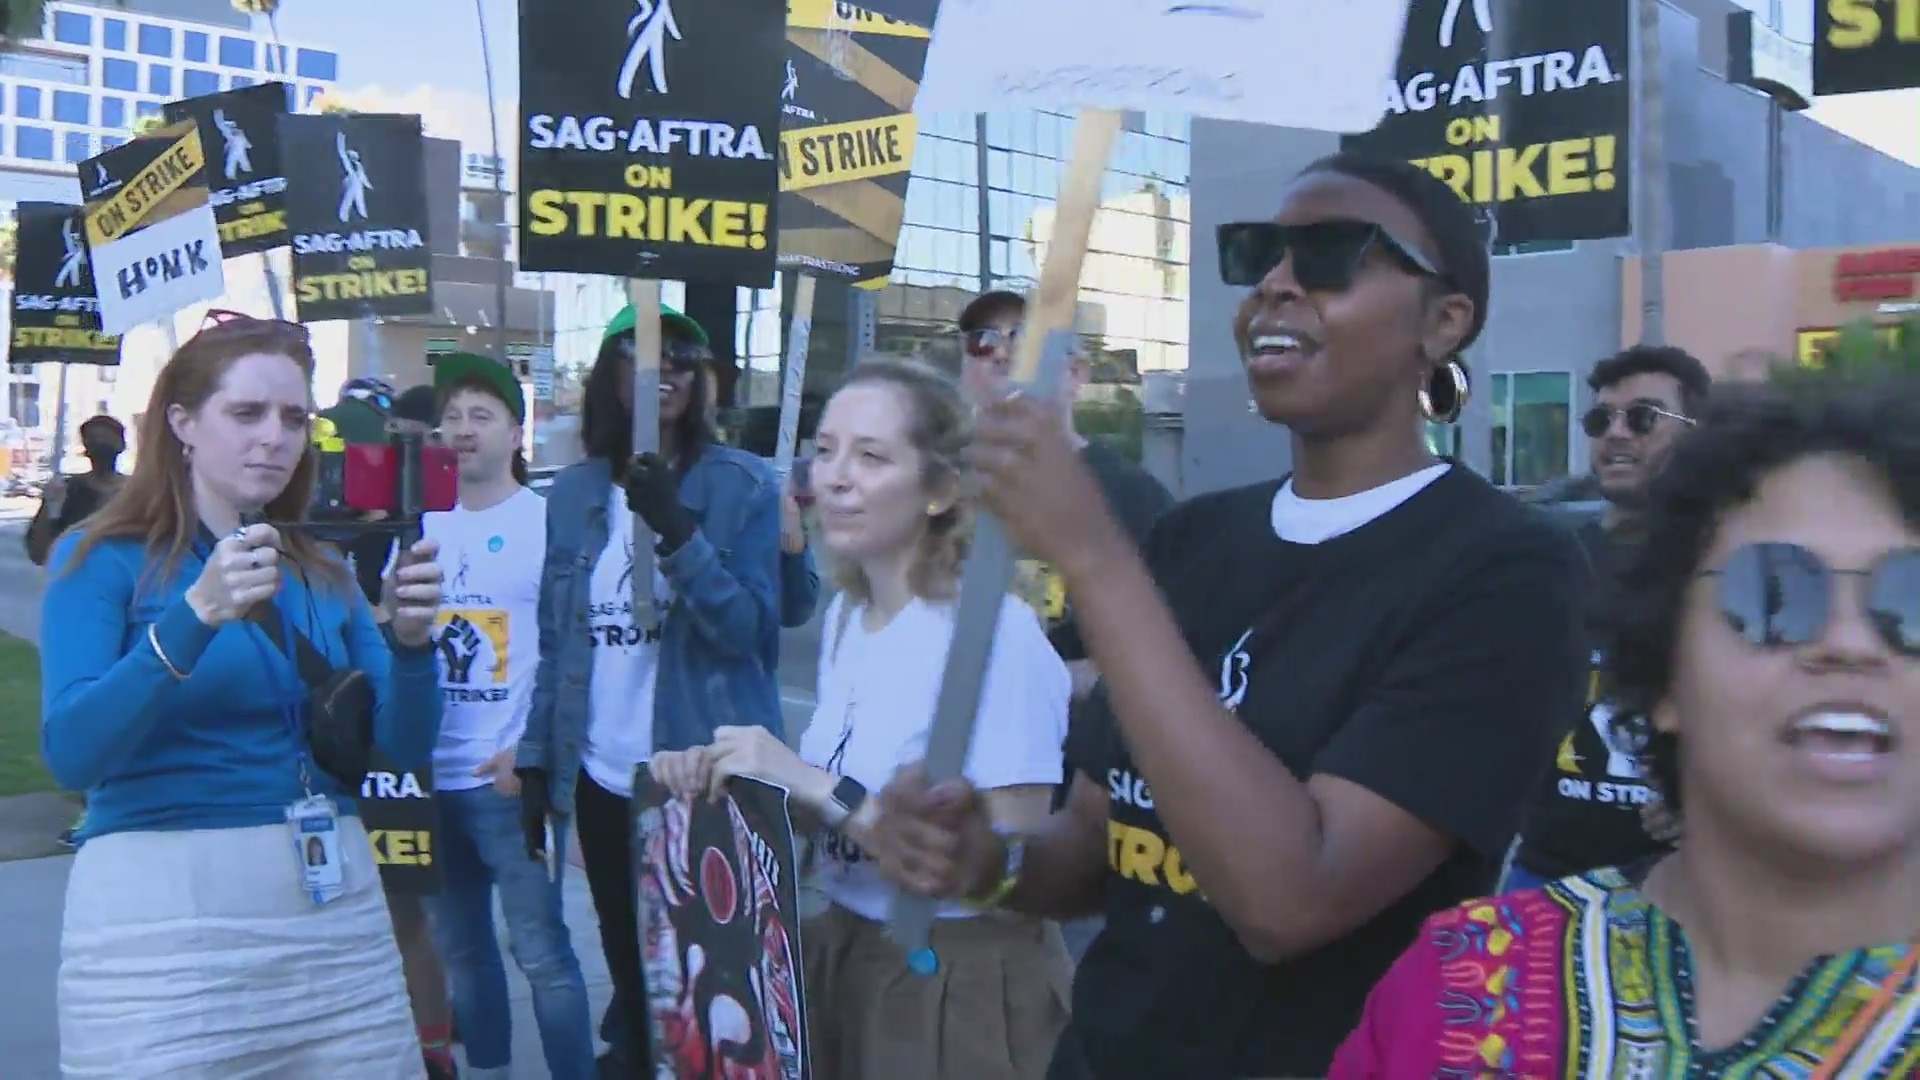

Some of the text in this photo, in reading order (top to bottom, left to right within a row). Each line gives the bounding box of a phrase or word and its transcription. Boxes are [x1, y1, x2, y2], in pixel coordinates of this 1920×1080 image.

[799, 124, 902, 176] STRIKE
[1445, 115, 1499, 146] ON
[623, 164, 672, 190] ON
[1408, 135, 1616, 203] RIKE!
[97, 203, 126, 237] ON
[125, 146, 195, 213] STRIKE
[528, 190, 769, 250] STRIKE!
[297, 268, 427, 302] STRIKE!
[1557, 777, 1592, 800] ON
